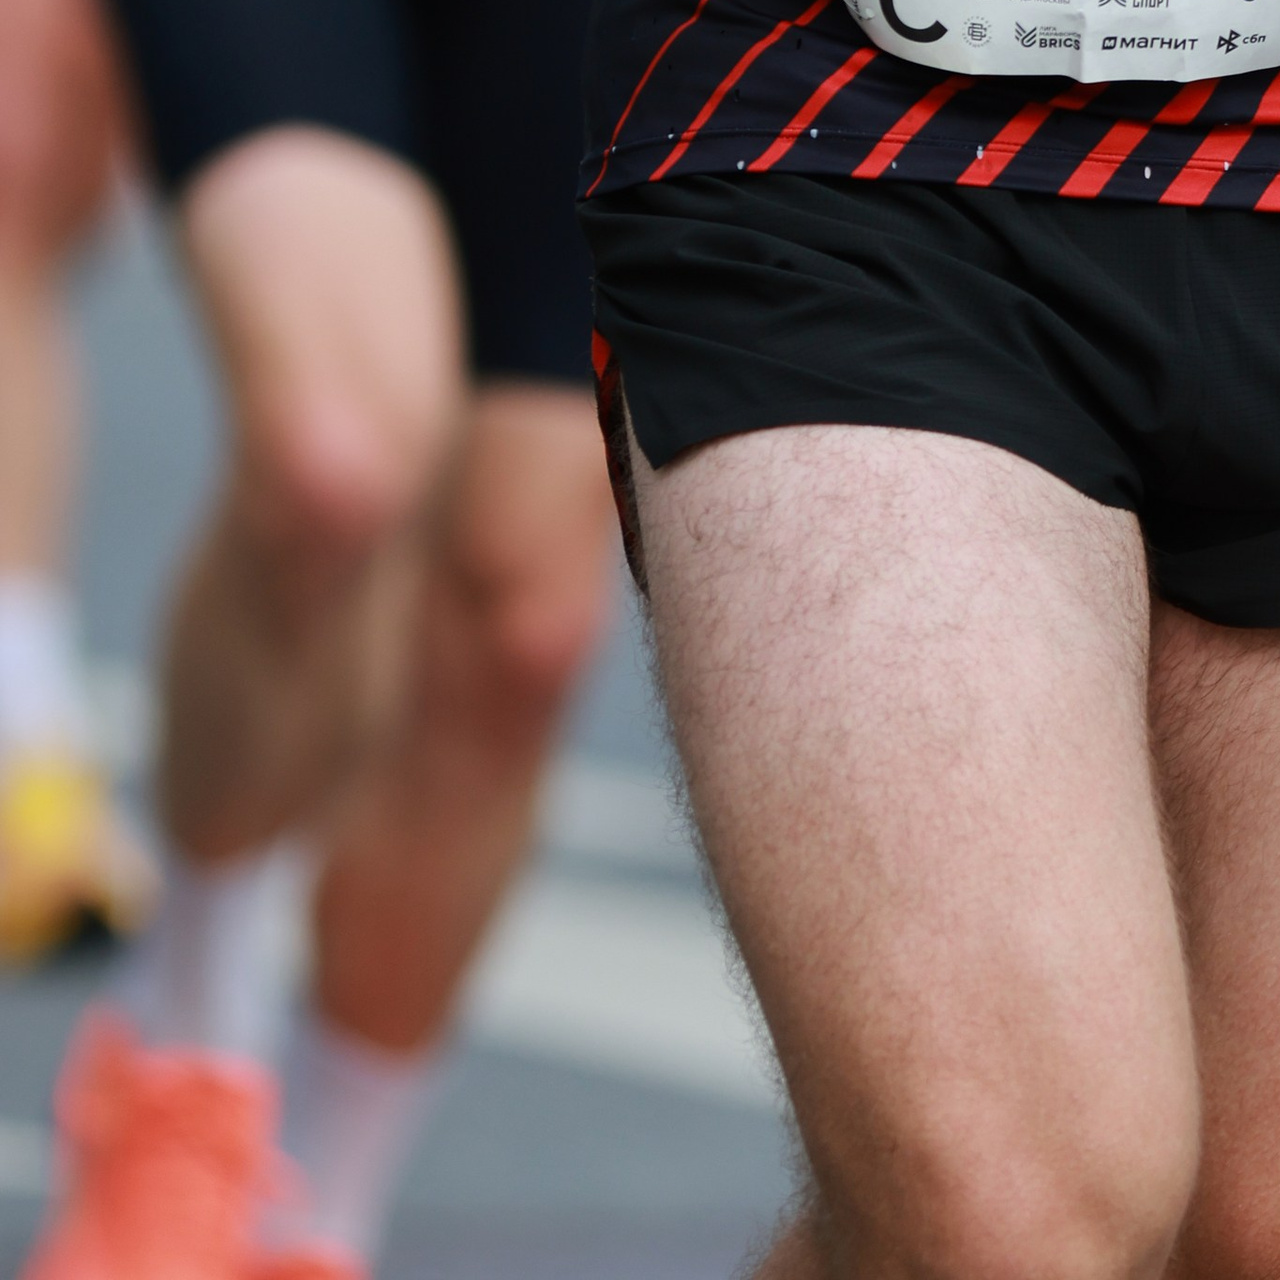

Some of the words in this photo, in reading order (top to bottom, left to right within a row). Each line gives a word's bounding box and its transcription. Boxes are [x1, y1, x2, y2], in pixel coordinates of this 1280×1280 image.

[1039, 38, 1081, 51] BRICS
[1119, 36, 1199, 51] магнит
[1242, 33, 1267, 45] сбп
